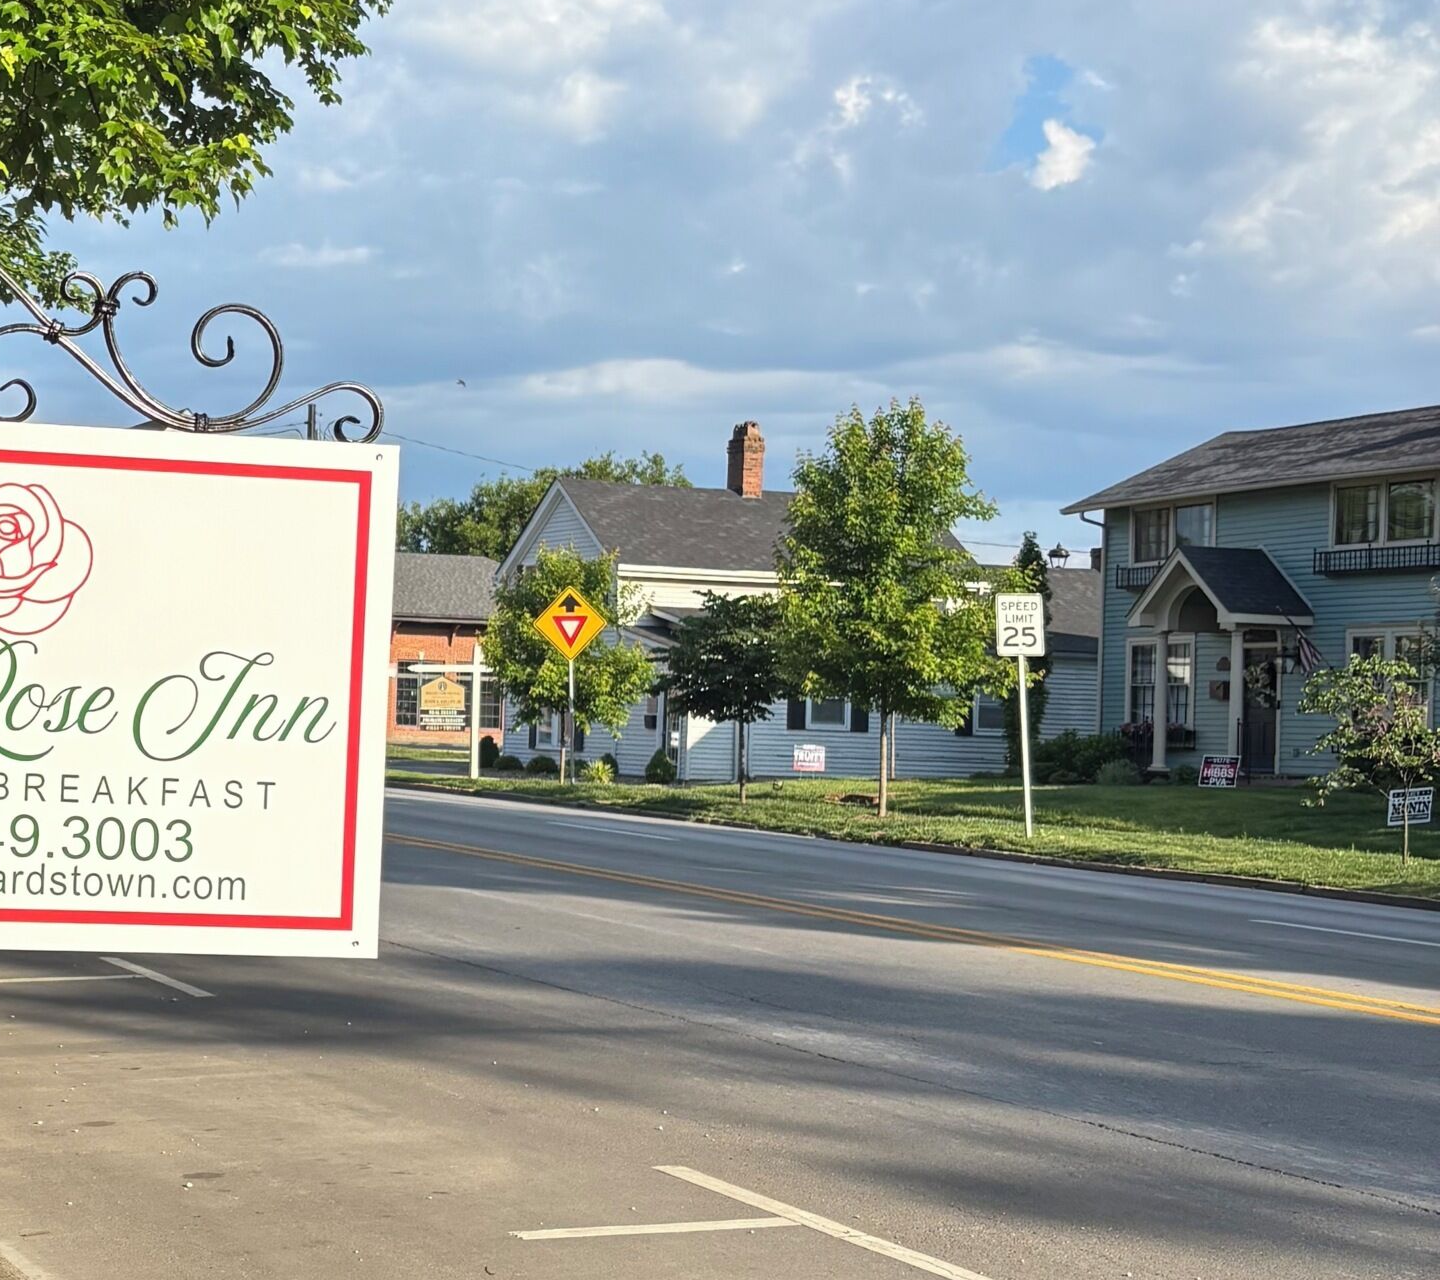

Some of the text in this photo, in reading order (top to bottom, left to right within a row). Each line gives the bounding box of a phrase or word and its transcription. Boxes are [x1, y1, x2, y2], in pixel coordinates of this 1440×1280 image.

[1000, 601, 1038, 611] SPEED
[1005, 614, 1034, 624] LIMIT
[1003, 626, 1038, 647] 25
[132, 650, 337, 762] Inn
[1203, 767, 1234, 778] HIBBS
